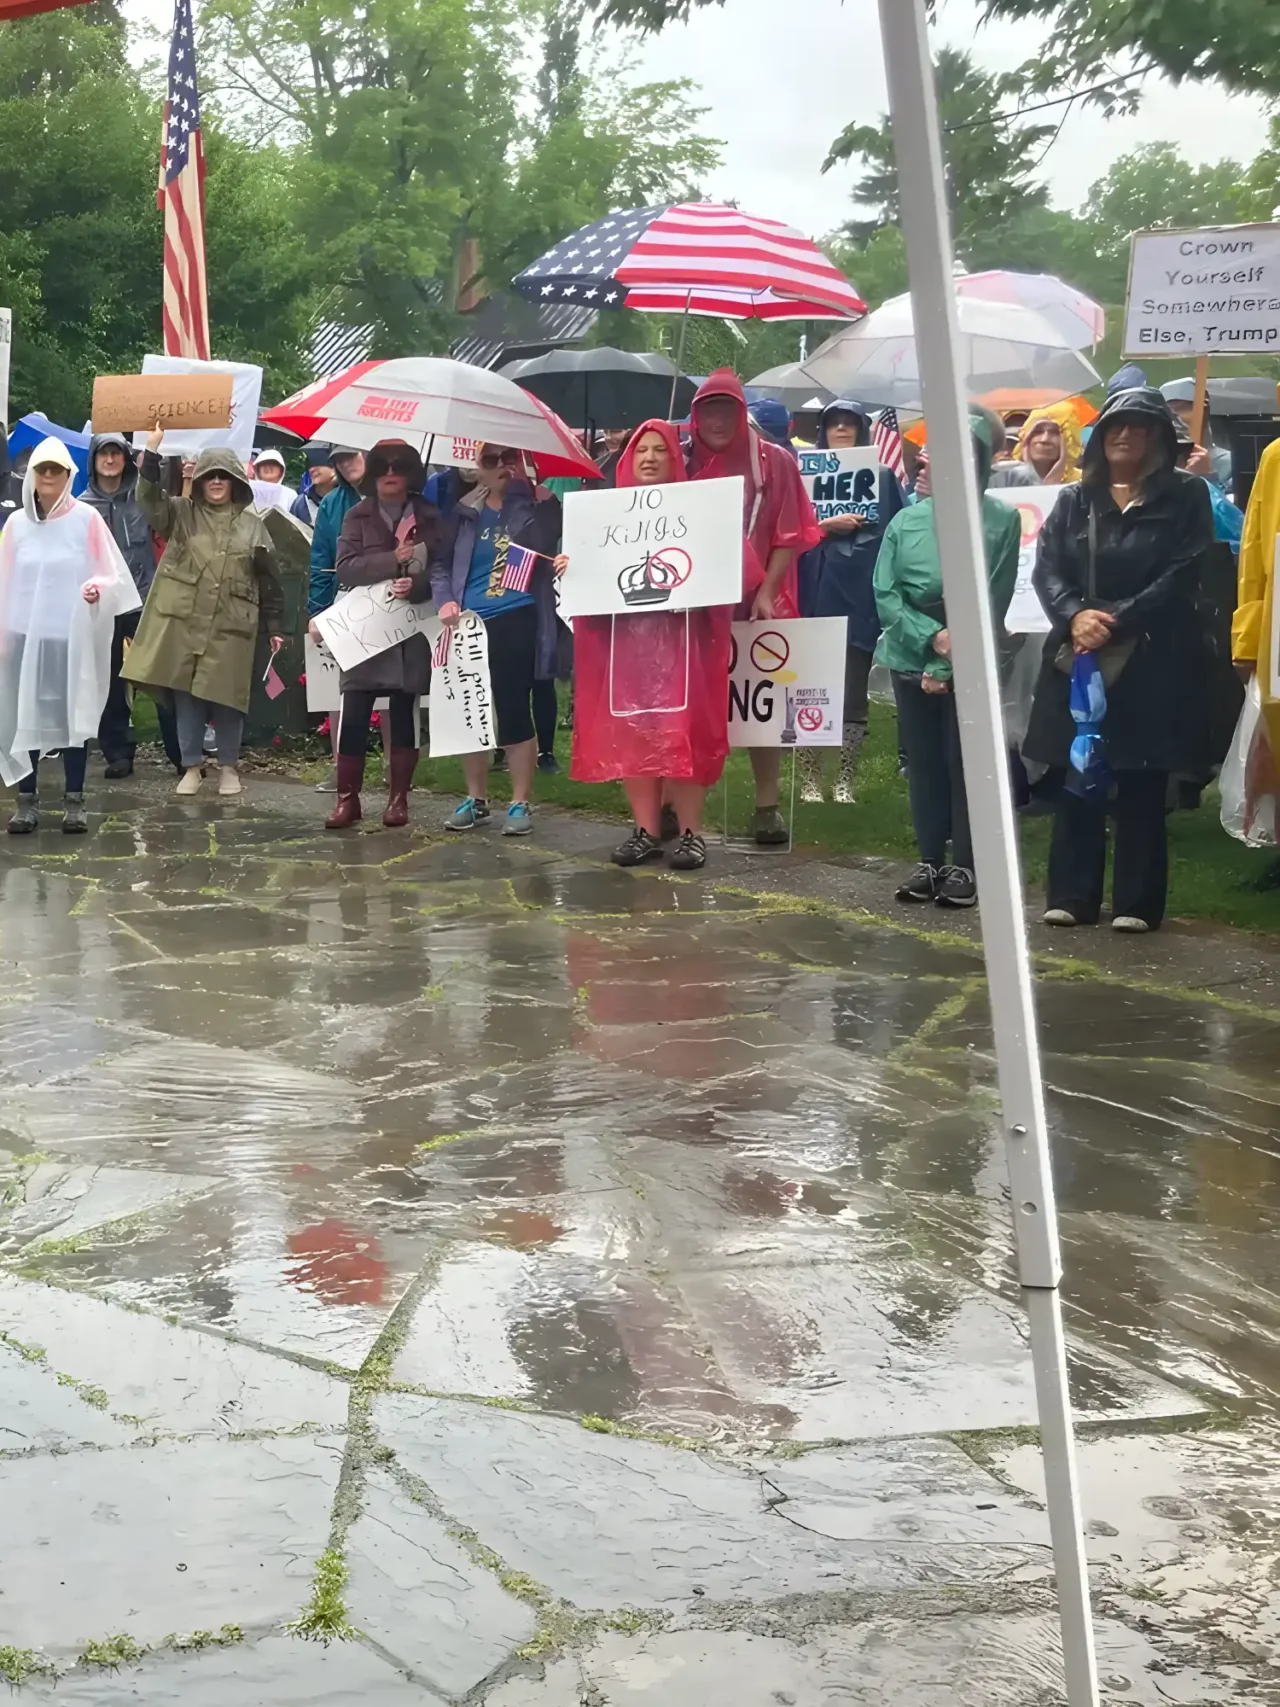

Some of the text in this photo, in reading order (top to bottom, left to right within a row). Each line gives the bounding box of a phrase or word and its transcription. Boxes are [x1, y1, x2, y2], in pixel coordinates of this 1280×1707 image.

[1179, 240, 1254, 257] Crown
[1165, 266, 1265, 286] Yourself
[1138, 325, 1278, 344] Else, Trump
[813, 468, 877, 503] HER
[624, 487, 664, 513] NO
[811, 501, 880, 525] HOICE
[727, 679, 774, 723] NG
